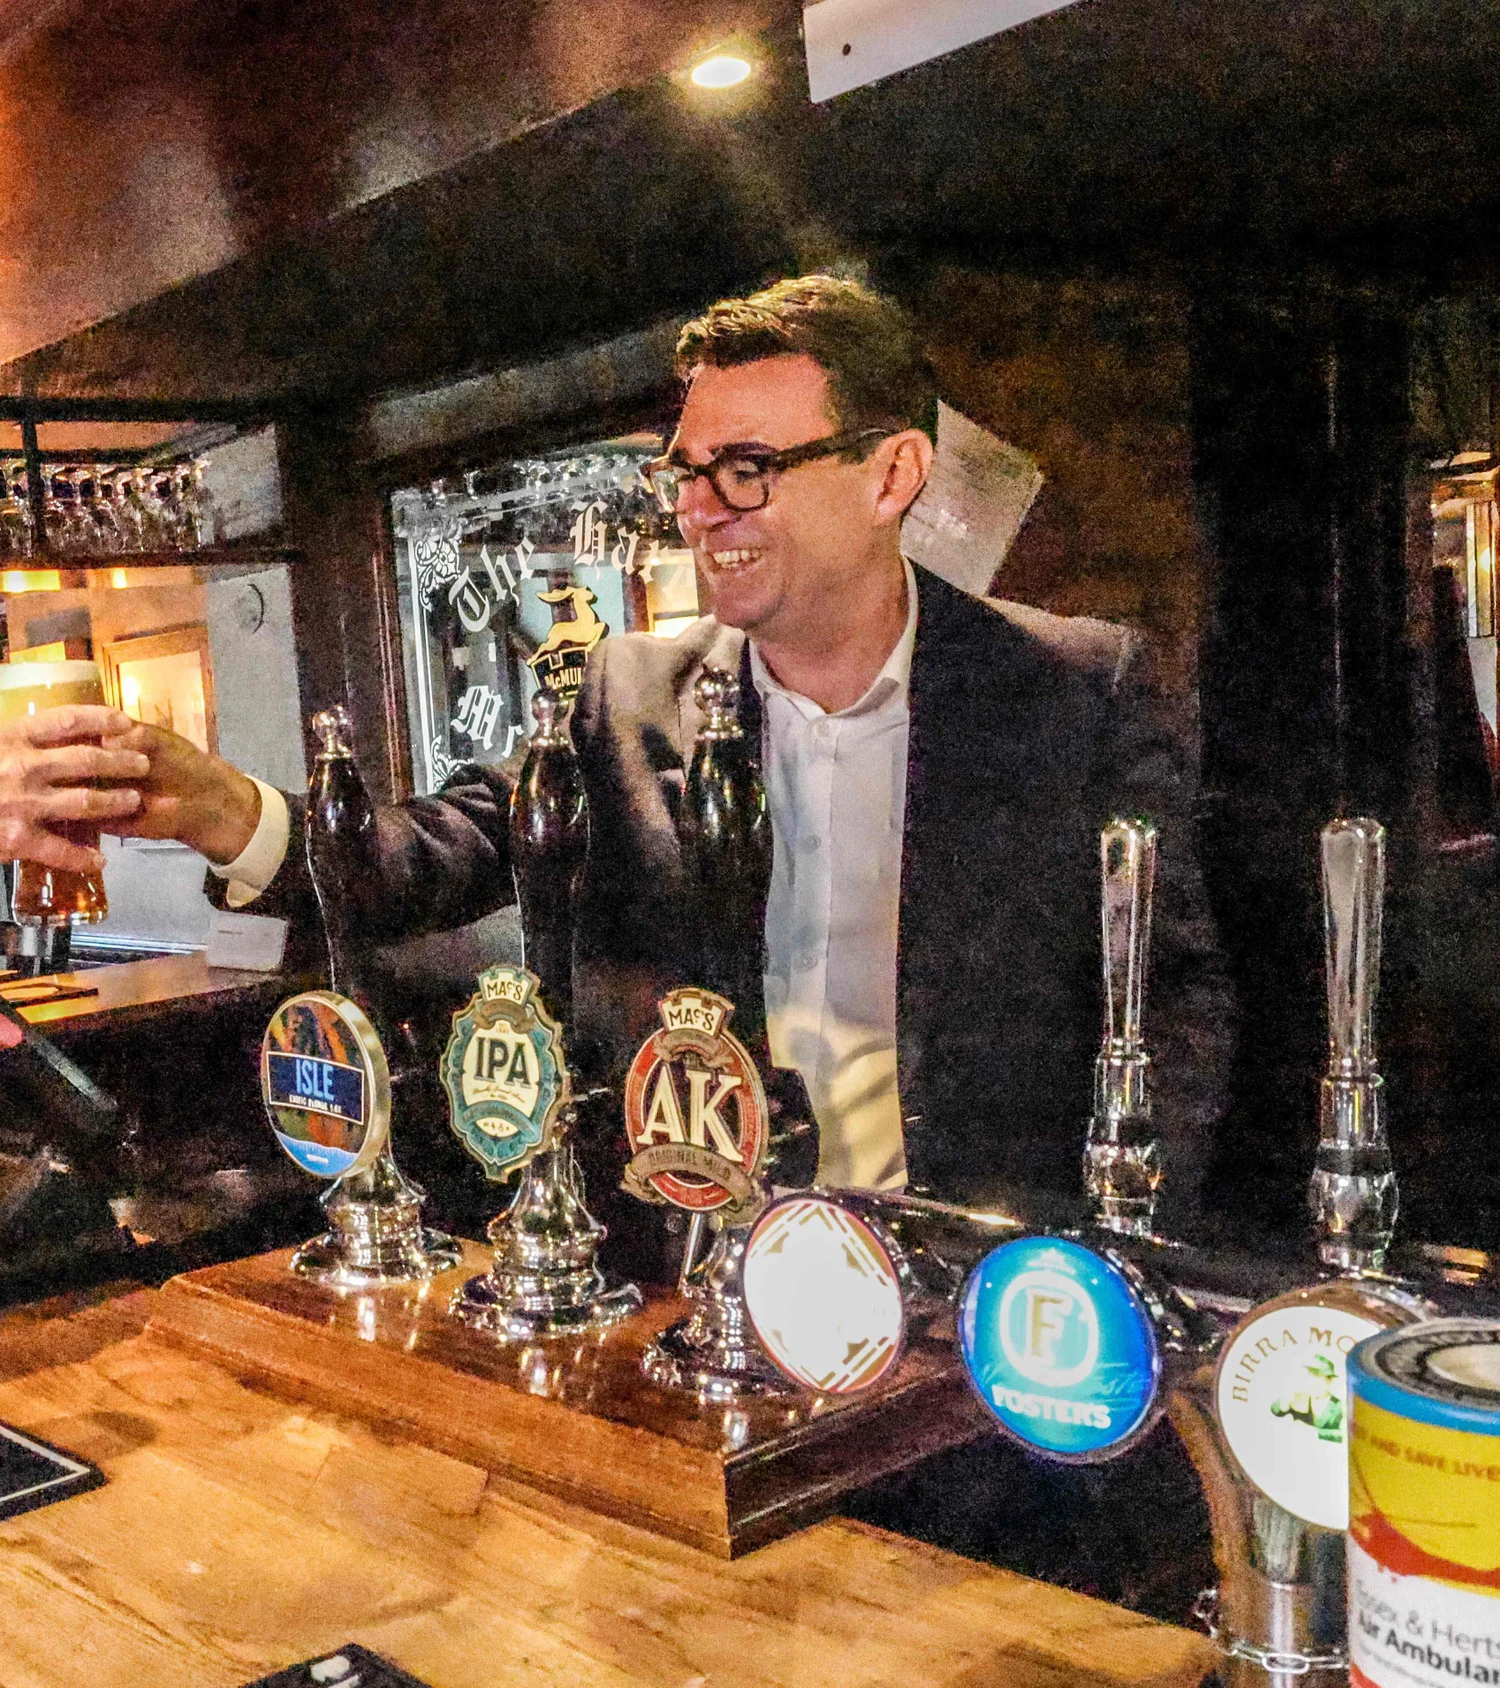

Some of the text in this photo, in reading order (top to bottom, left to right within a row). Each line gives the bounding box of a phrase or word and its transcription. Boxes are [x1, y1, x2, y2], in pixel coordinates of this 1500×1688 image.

[449, 536, 535, 633] The
[296, 1058, 335, 1101] ISLE
[474, 1037, 532, 1089] IPA
[636, 1065, 744, 1163] AK
[649, 1149, 698, 1166] ORIGINAL
[1232, 1327, 1357, 1403] BIRRA MO
[1453, 1460, 1500, 1482] LIVE
[1406, 1609, 1423, 1636] &
